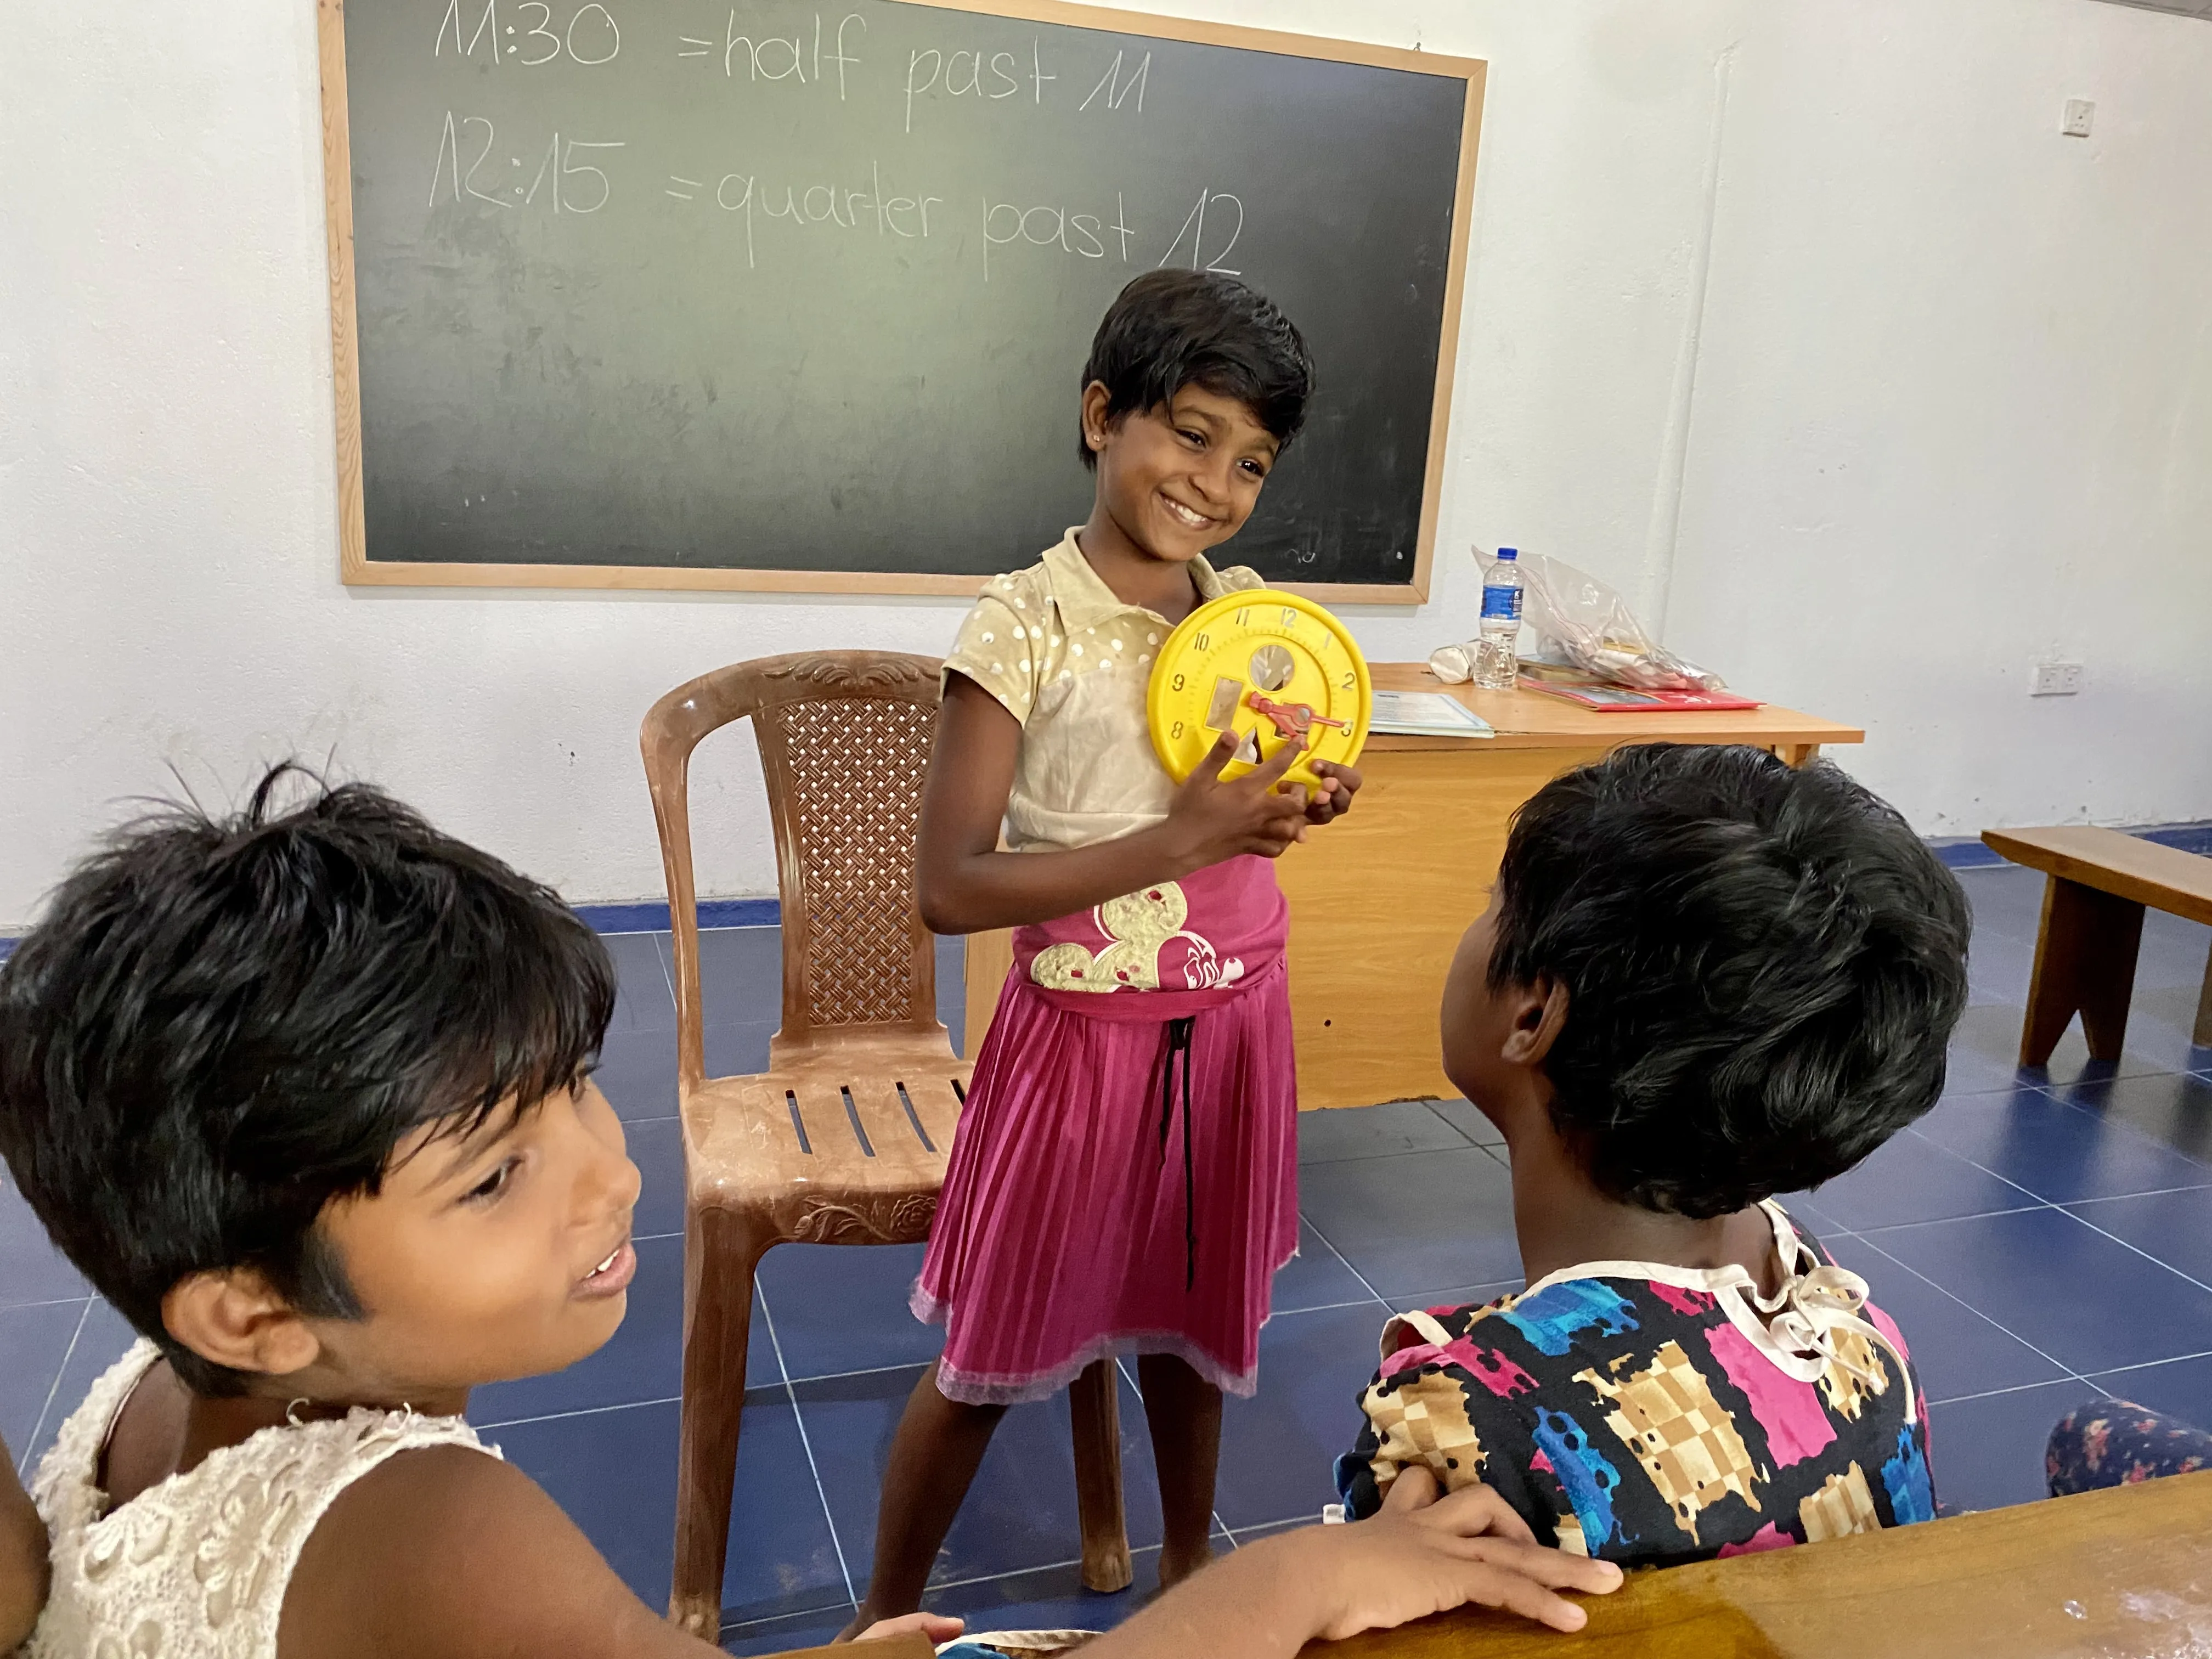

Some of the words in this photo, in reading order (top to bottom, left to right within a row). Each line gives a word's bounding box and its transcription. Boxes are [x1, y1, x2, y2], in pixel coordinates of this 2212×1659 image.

[436, 0, 619, 65] 11:30
[725, 7, 867, 100] half
[903, 35, 1056, 133] past
[1079, 50, 1150, 112] 11
[429, 111, 625, 213] 12:15
[717, 160, 943, 268] quarter
[983, 191, 1135, 282] past
[1158, 187, 1243, 275] 12
[1235, 607, 1250, 627] 11
[1280, 607, 1297, 629] 12
[1193, 632, 1210, 652] 10
[1323, 632, 1332, 650] 1
[1171, 674, 1185, 692] 9
[1342, 673, 1356, 691] 2
[1171, 721, 1183, 740] 8
